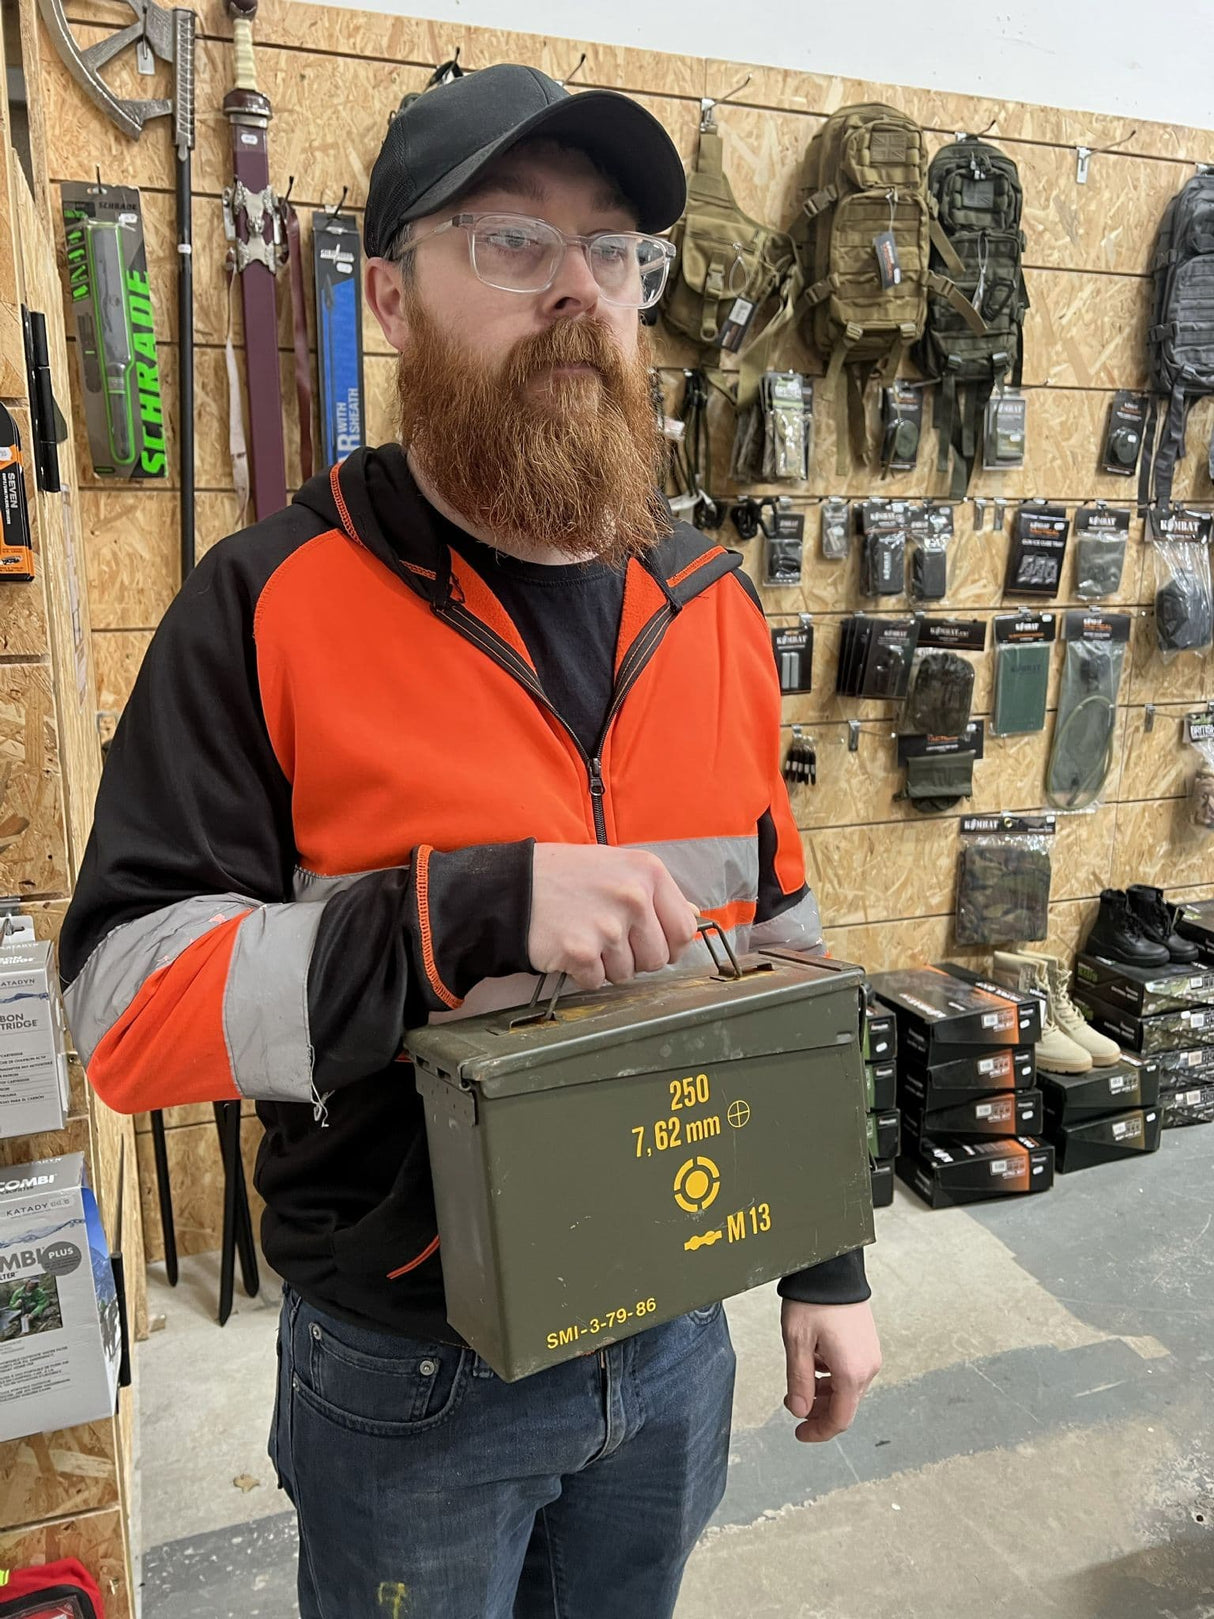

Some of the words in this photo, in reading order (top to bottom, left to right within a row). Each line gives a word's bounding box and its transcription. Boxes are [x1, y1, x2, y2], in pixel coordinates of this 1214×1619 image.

[100, 202, 137, 210] SCHRADE
[126, 270, 166, 474] SCHRADE
[336, 402, 347, 433] WITH
[348, 388, 360, 434] SHEATH
[8, 472, 18, 509] SEVEN
[1089, 515, 1116, 526] KOMBAT
[1160, 515, 1199, 532] KOMBAT
[776, 633, 808, 645] KOMBAT
[964, 818, 999, 830] KOMBAT
[1, 979, 35, 987] ATADYN
[0, 1019, 38, 1031] TRIDGE
[669, 1073, 710, 1111] 250
[631, 1116, 682, 1158] 7,62
[685, 1115, 721, 1144] mm
[6, 1202, 48, 1217] KATADY
[48, 1246, 74, 1260] PLUS
[546, 1297, 657, 1350] SMI-3-79-86
